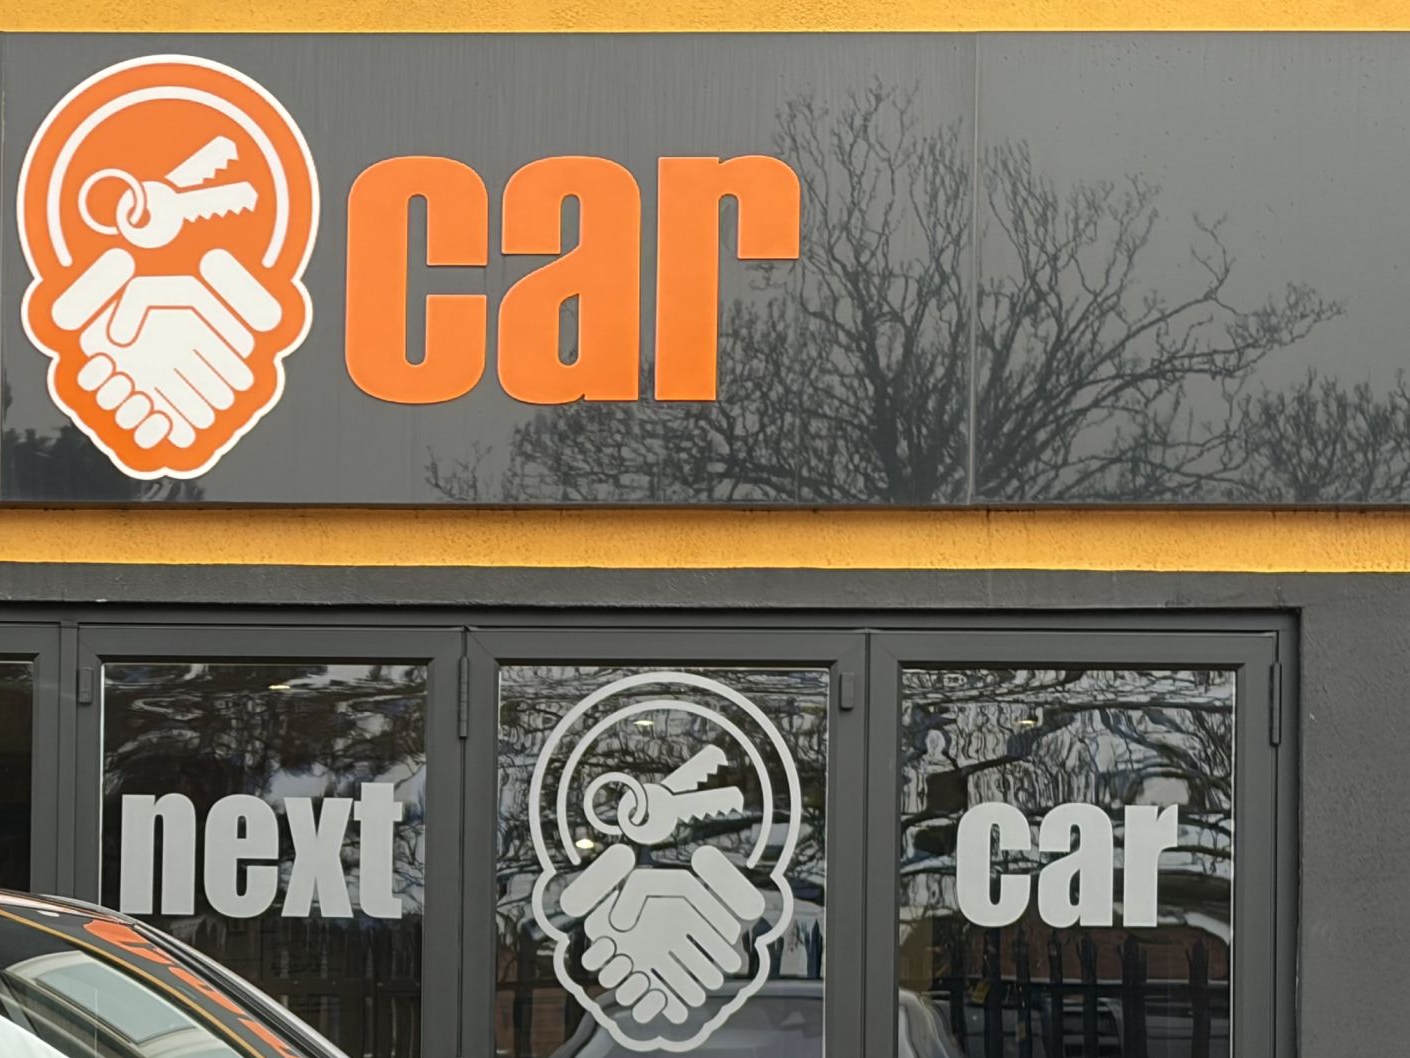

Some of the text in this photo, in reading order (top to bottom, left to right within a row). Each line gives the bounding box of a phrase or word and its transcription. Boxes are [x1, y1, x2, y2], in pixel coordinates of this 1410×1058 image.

[345, 156, 802, 405] car
[120, 783, 403, 919] next
[956, 802, 1179, 928] car
